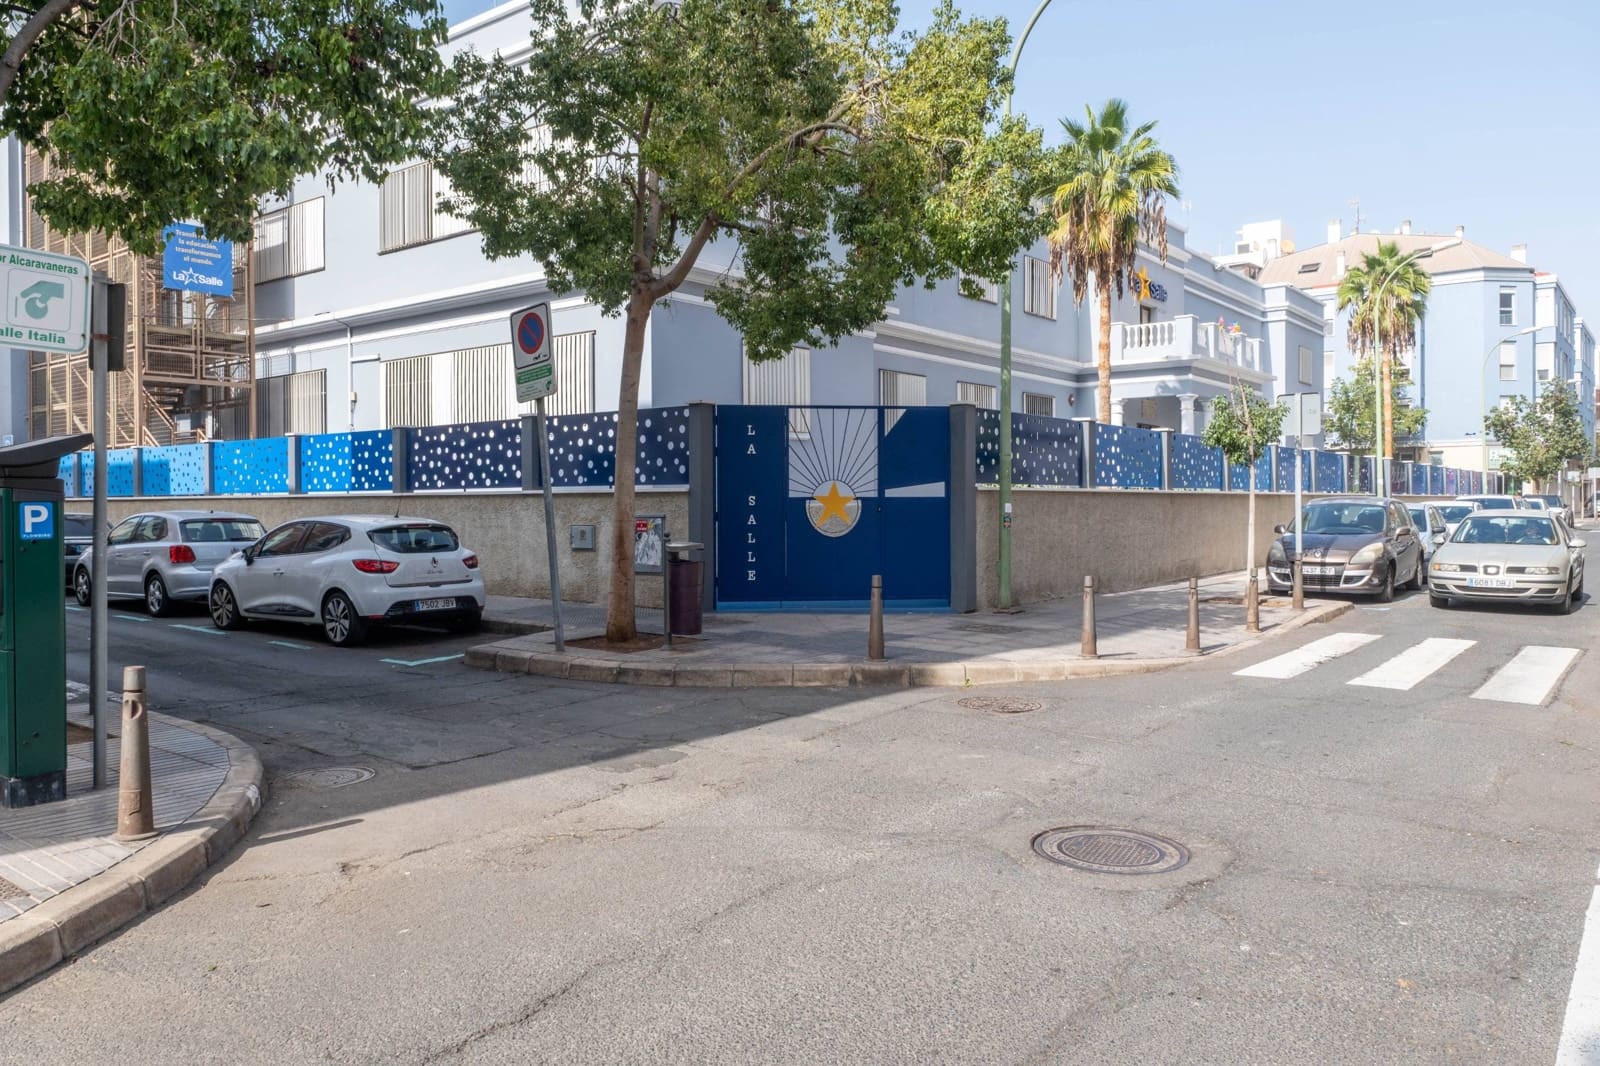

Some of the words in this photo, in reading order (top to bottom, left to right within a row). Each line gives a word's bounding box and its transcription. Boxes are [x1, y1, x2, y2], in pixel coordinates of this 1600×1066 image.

[9, 254, 79, 275] Alcaravaneras
[172, 271, 186, 281] La
[198, 274, 224, 287] Salle
[0, 327, 23, 339] alle
[28, 329, 66, 344] Italia
[747, 424, 757, 454] LA
[24, 505, 49, 533] P
[747, 495, 757, 581] SALLE
[420, 600, 440, 609] 7502
